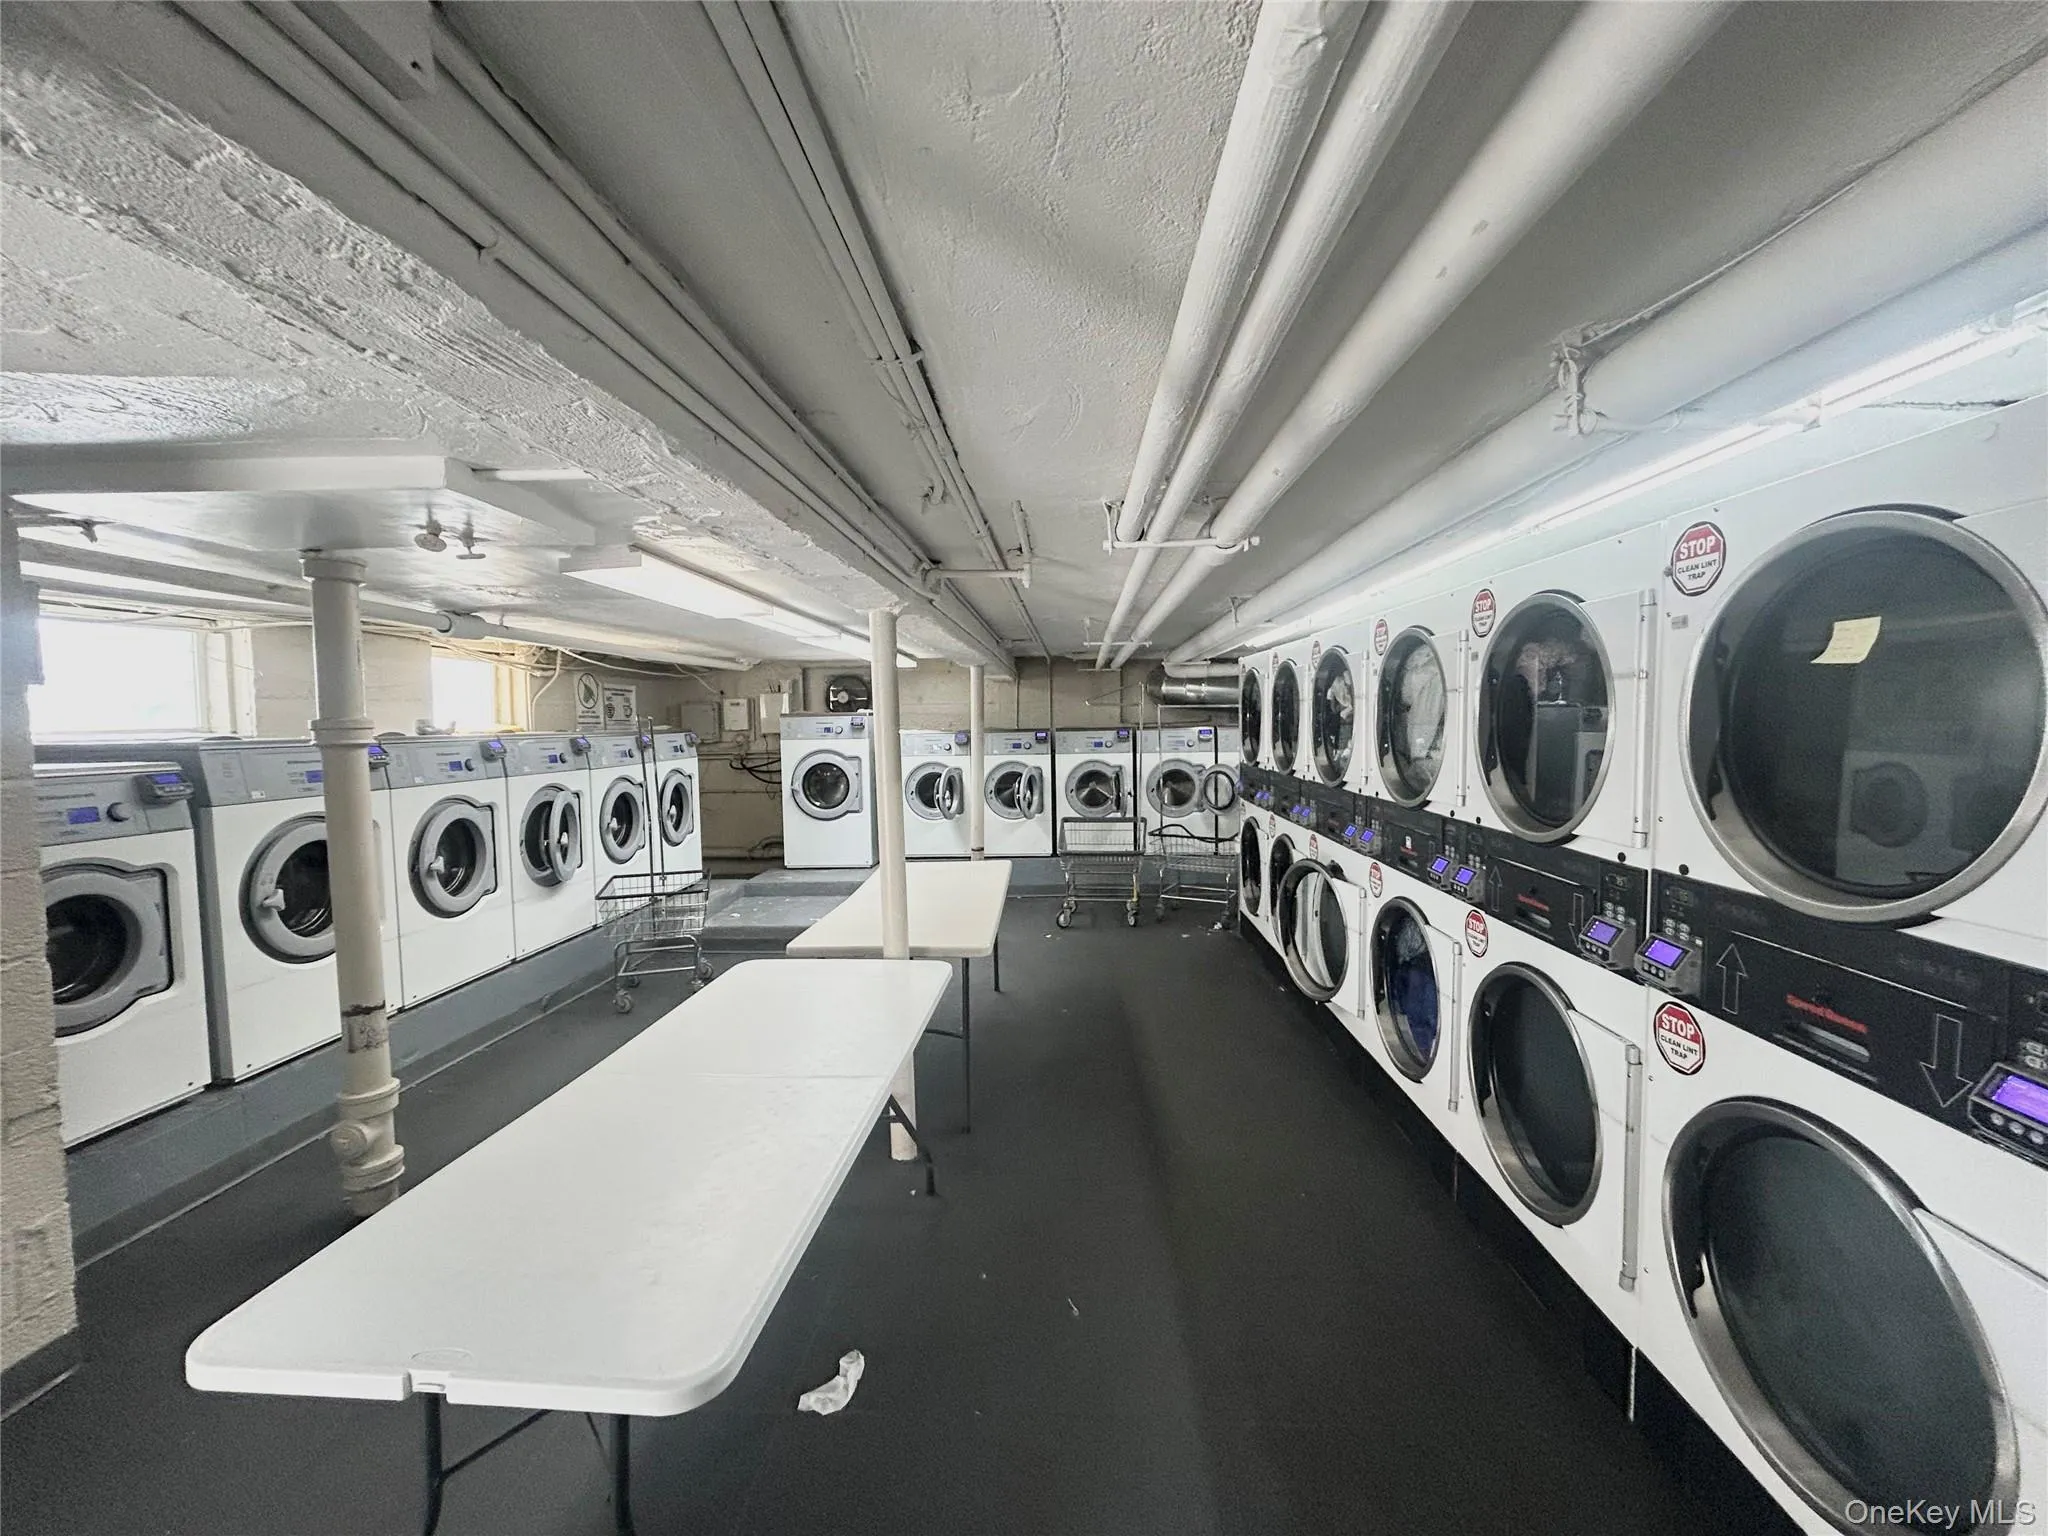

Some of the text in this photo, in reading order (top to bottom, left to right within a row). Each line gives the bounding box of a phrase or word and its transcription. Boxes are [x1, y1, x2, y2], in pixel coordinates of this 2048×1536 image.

[1680, 535, 1715, 559] STOP
[1677, 559, 1717, 574] CLEAN LINT
[1687, 571, 1706, 581] TRAP
[1661, 1013, 1695, 1039] STOP
[1660, 1035, 1698, 1056] CLEAN LINT
[1670, 1047, 1688, 1059] TRAP
